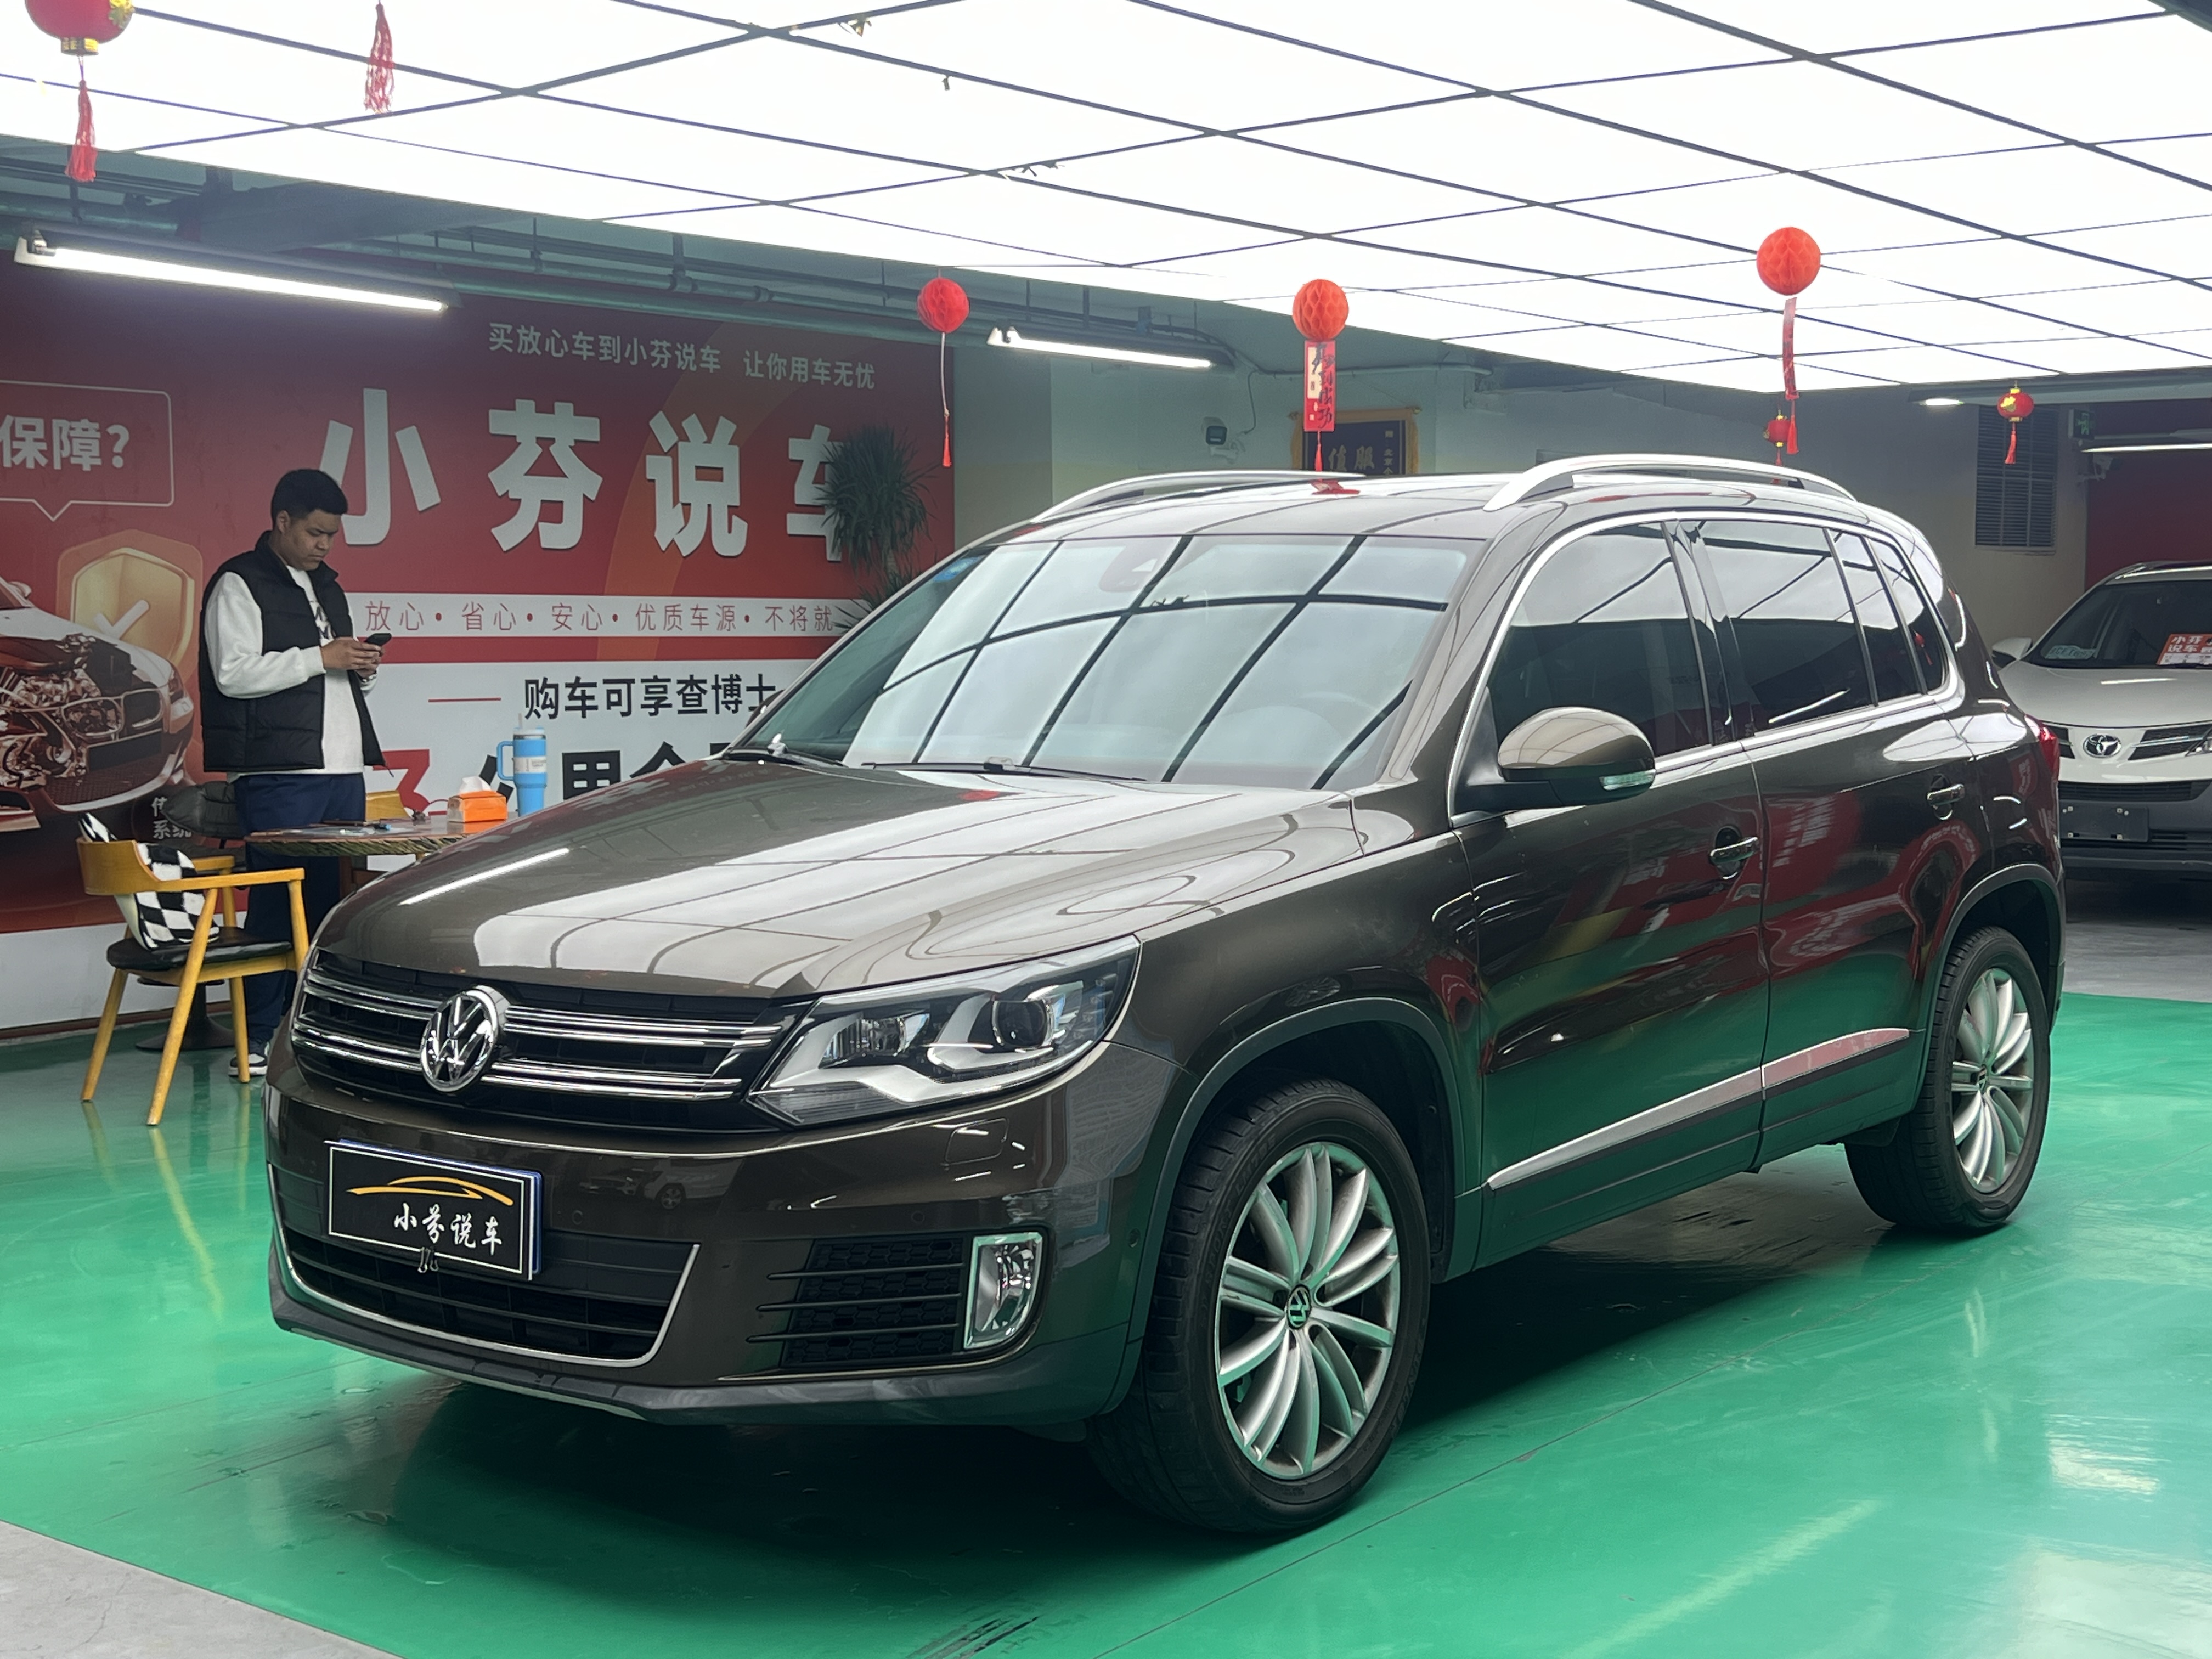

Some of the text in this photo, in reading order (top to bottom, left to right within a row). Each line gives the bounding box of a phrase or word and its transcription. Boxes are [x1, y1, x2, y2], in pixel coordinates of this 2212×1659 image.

[488, 321, 876, 390] 买放心车到小芬说车 让你用车无忧
[524, 673, 776, 720] 购车可享查博士
[393, 1202, 503, 1256] 小芬说车
